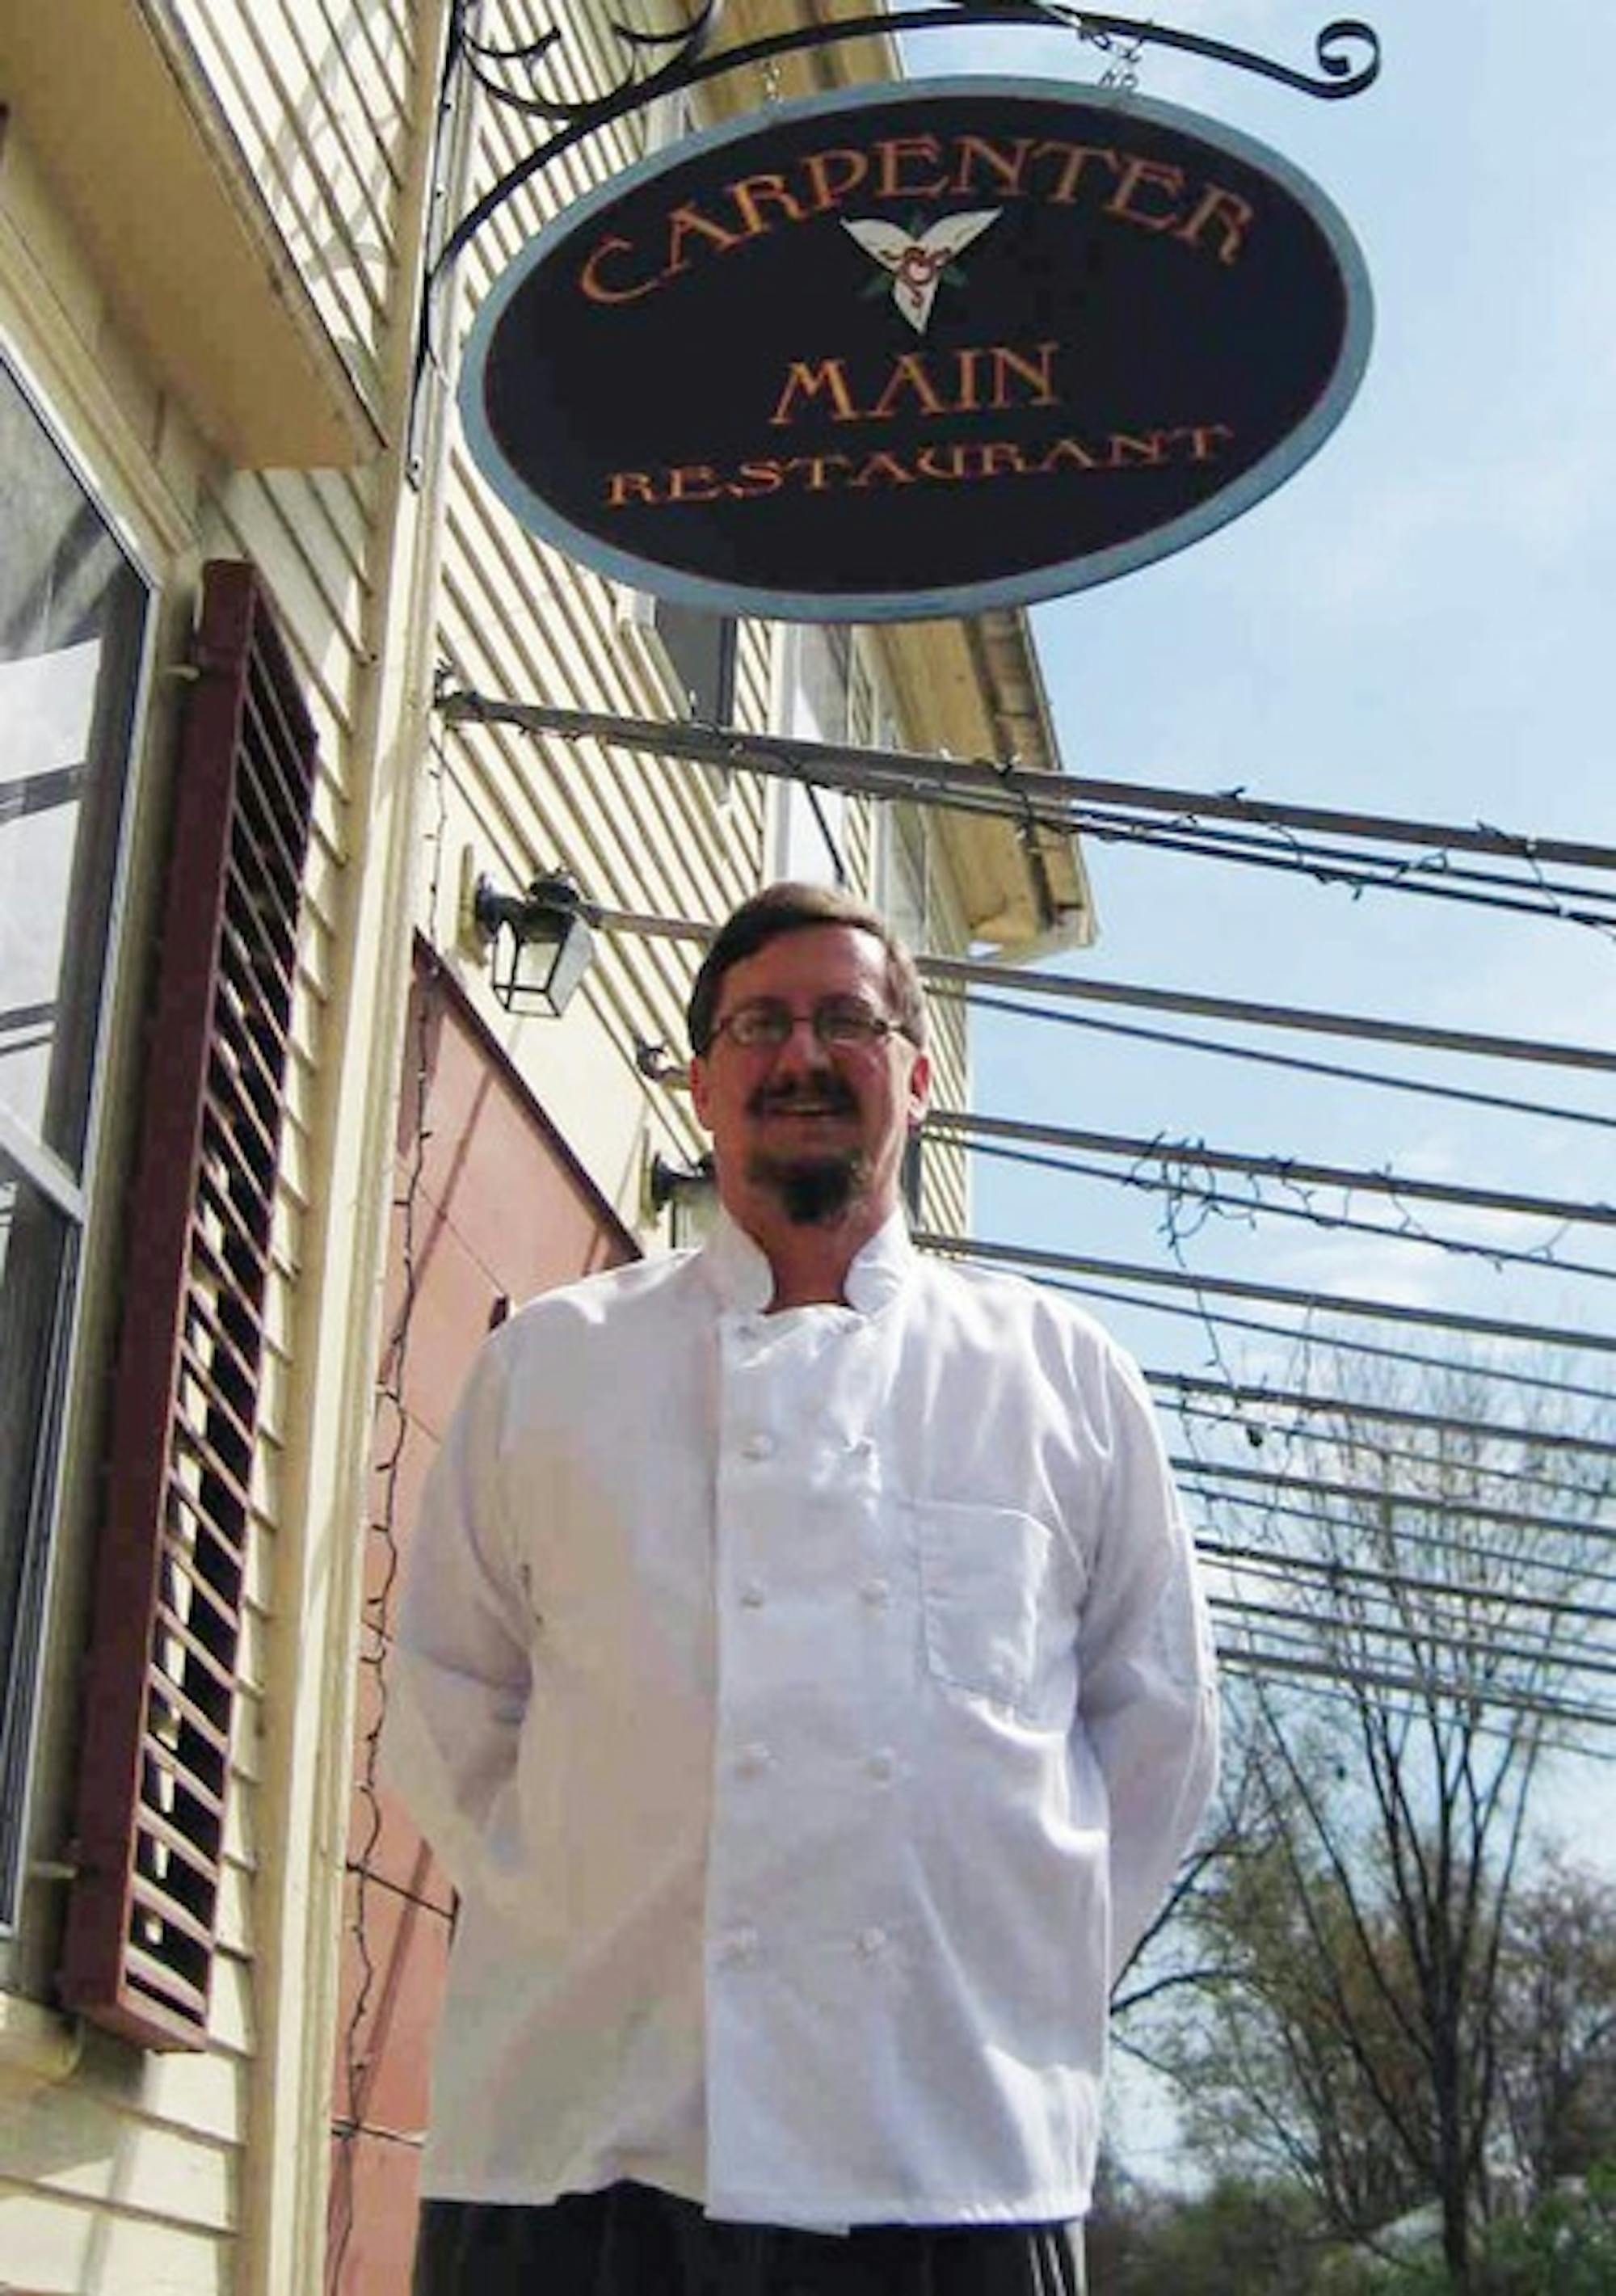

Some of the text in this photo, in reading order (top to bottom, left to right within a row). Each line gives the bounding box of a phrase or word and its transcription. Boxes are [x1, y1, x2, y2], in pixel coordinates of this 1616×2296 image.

[579, 134, 1253, 305] CARPENTER
[770, 342, 1060, 426] MAIN
[606, 424, 1235, 508] RESTAURANT
